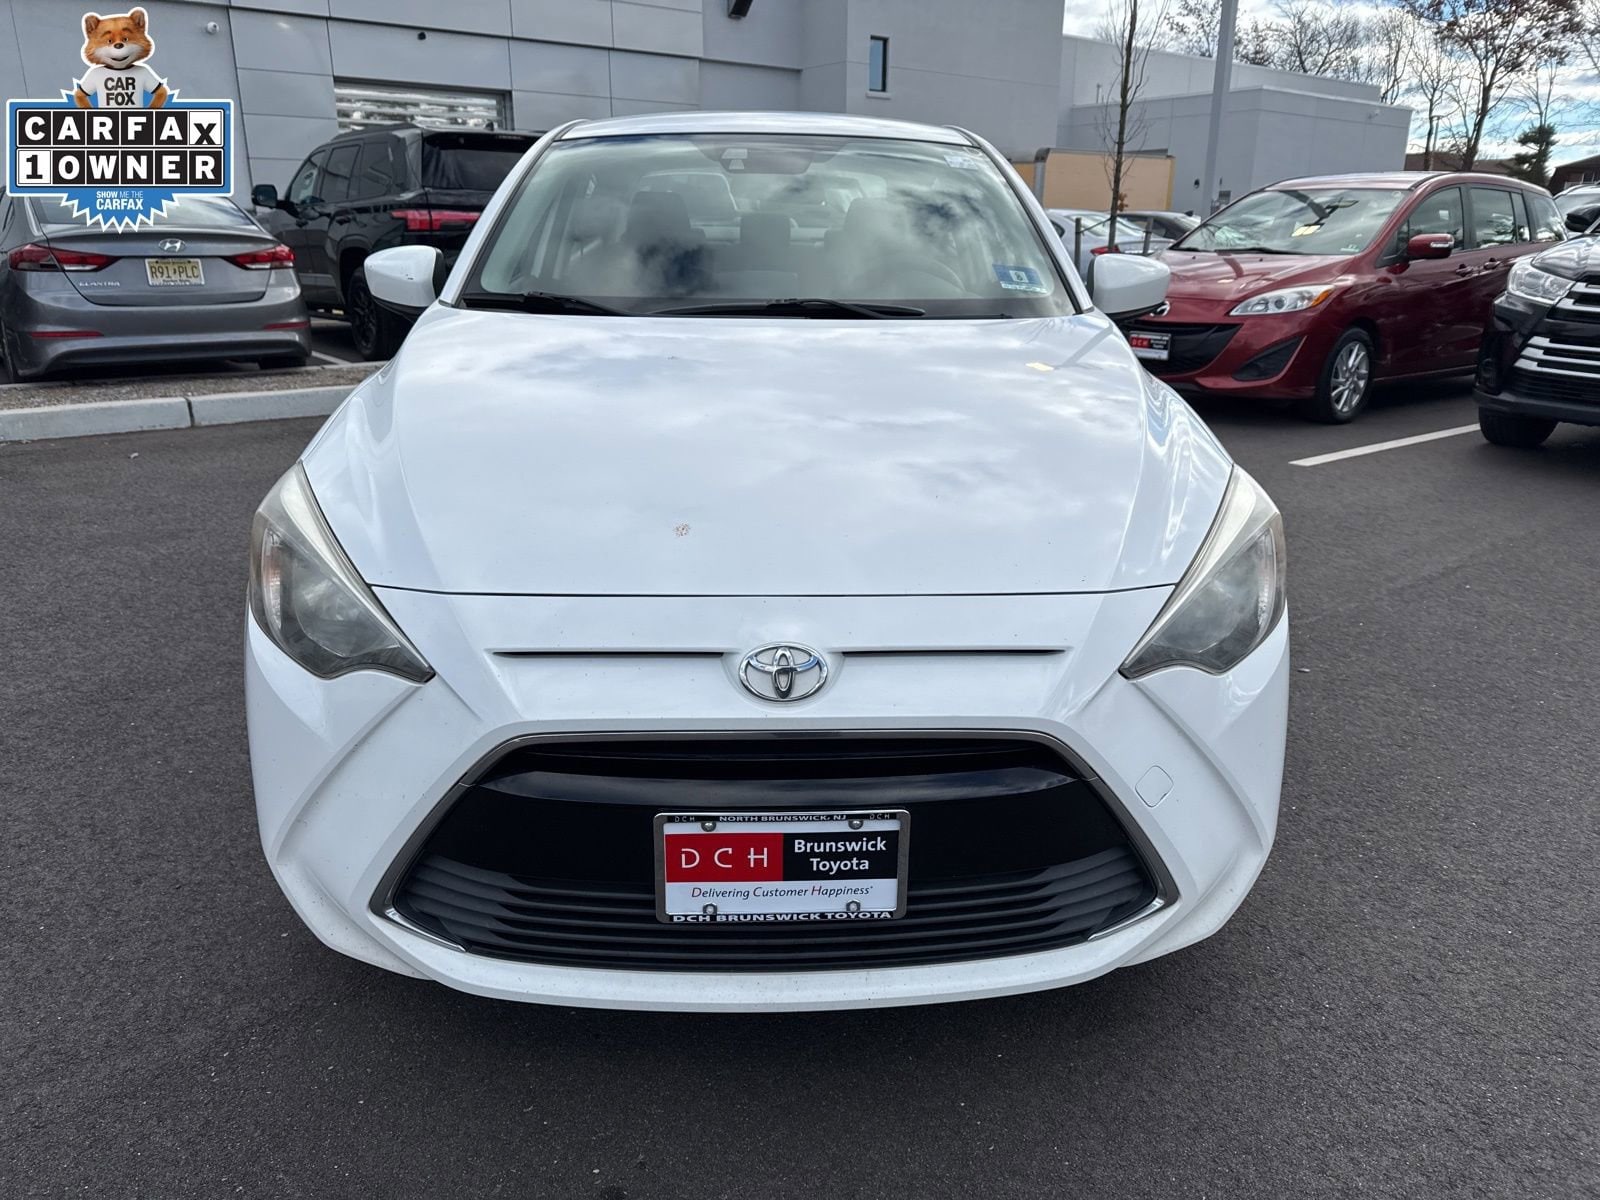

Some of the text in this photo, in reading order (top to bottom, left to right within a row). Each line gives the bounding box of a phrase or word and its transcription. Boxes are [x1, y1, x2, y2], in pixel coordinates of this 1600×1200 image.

[794, 837, 887, 853] Brunswick
[681, 848, 768, 868] DCH
[810, 857, 869, 875] Toyota
[691, 887, 751, 901] Delivering
[752, 886, 809, 898] Customer
[716, 913, 821, 922] BRUNSWICK
[826, 911, 892, 919] TOYOTA
